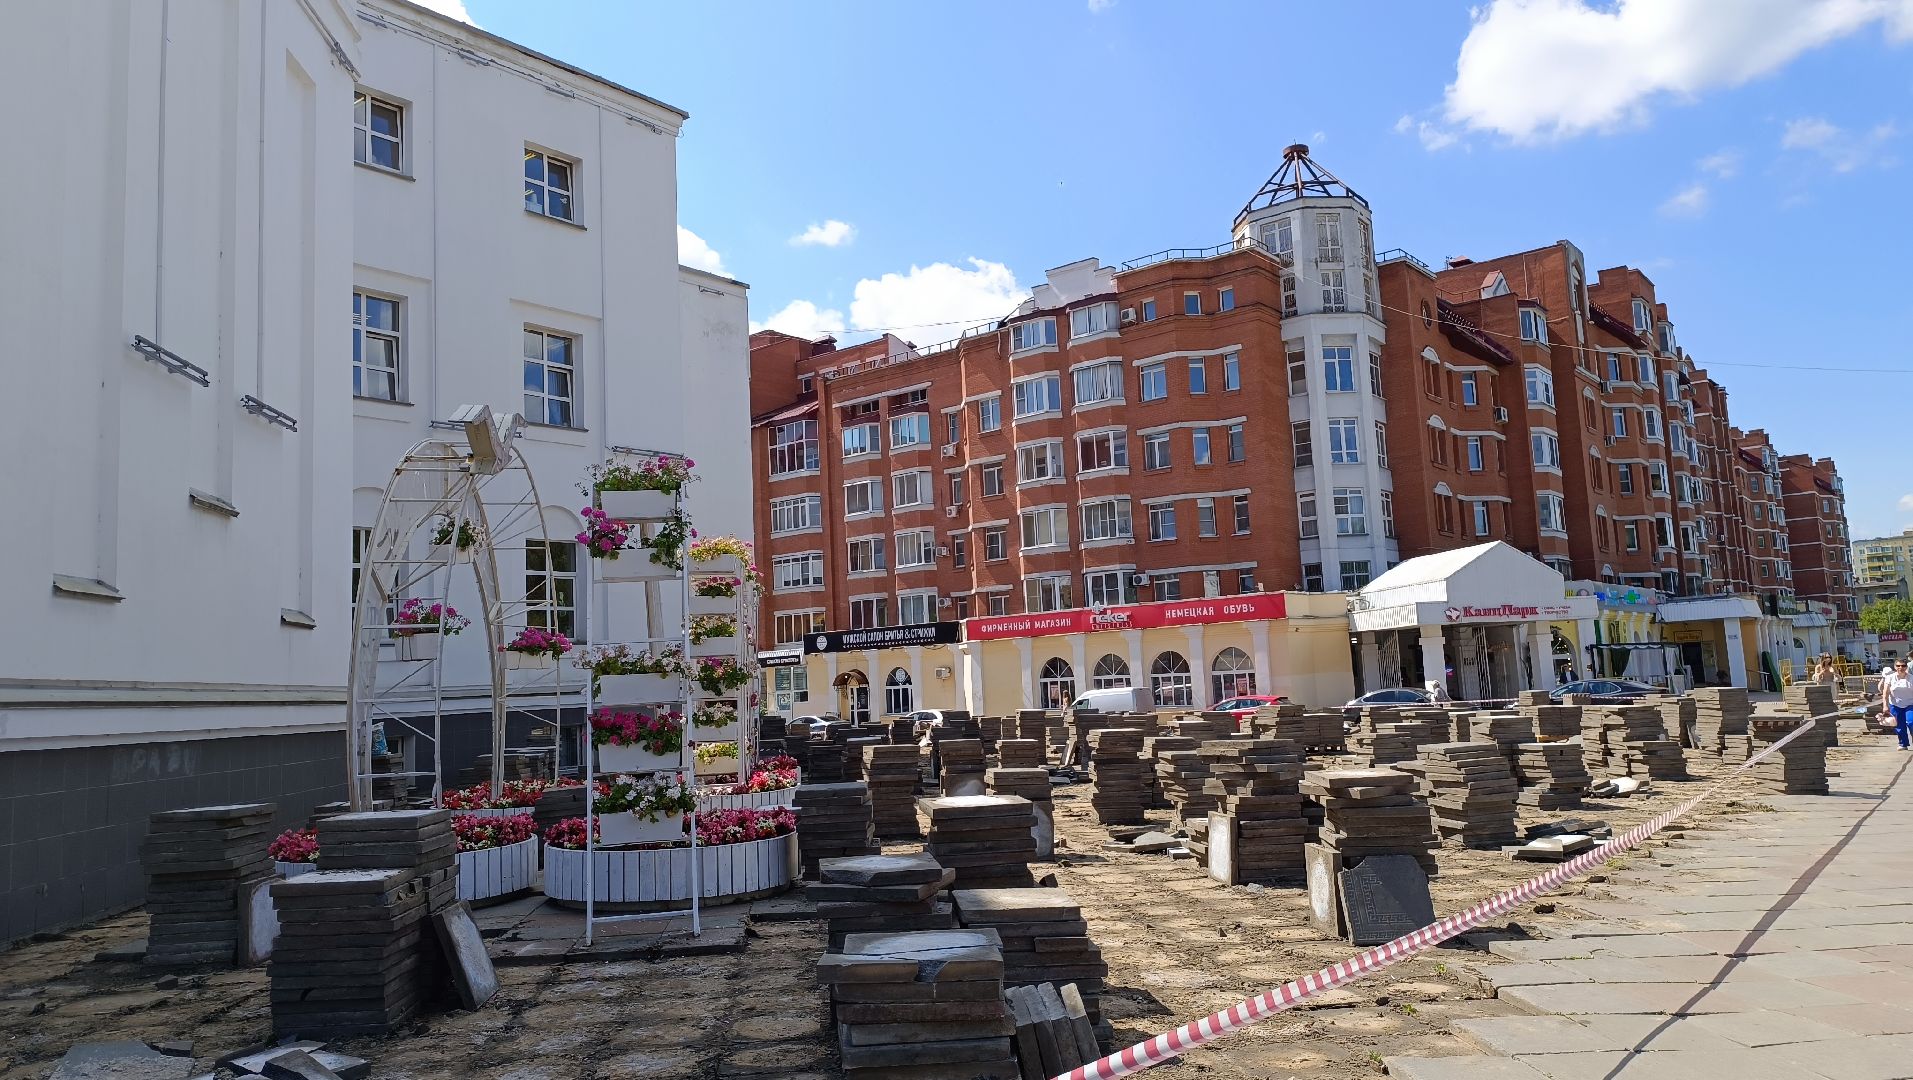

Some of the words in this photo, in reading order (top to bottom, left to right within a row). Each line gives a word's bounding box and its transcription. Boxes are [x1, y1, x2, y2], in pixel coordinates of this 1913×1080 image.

[1165, 606, 1214, 619] НЕМЕЦКАЯ
[1223, 603, 1255, 614] ОБУВЬ
[1462, 604, 1539, 618] КанцПарк
[981, 619, 1031, 633] ФИРМЕННЫЙ
[1034, 617, 1072, 629] МАГАЗИН
[842, 630, 867, 644] МУЖСКОЙ
[867, 631, 884, 642] САЛОН
[884, 629, 904, 640] БРИТЬЯ
[904, 628, 911, 639] &
[911, 626, 936, 638] СТРИЖКИ
